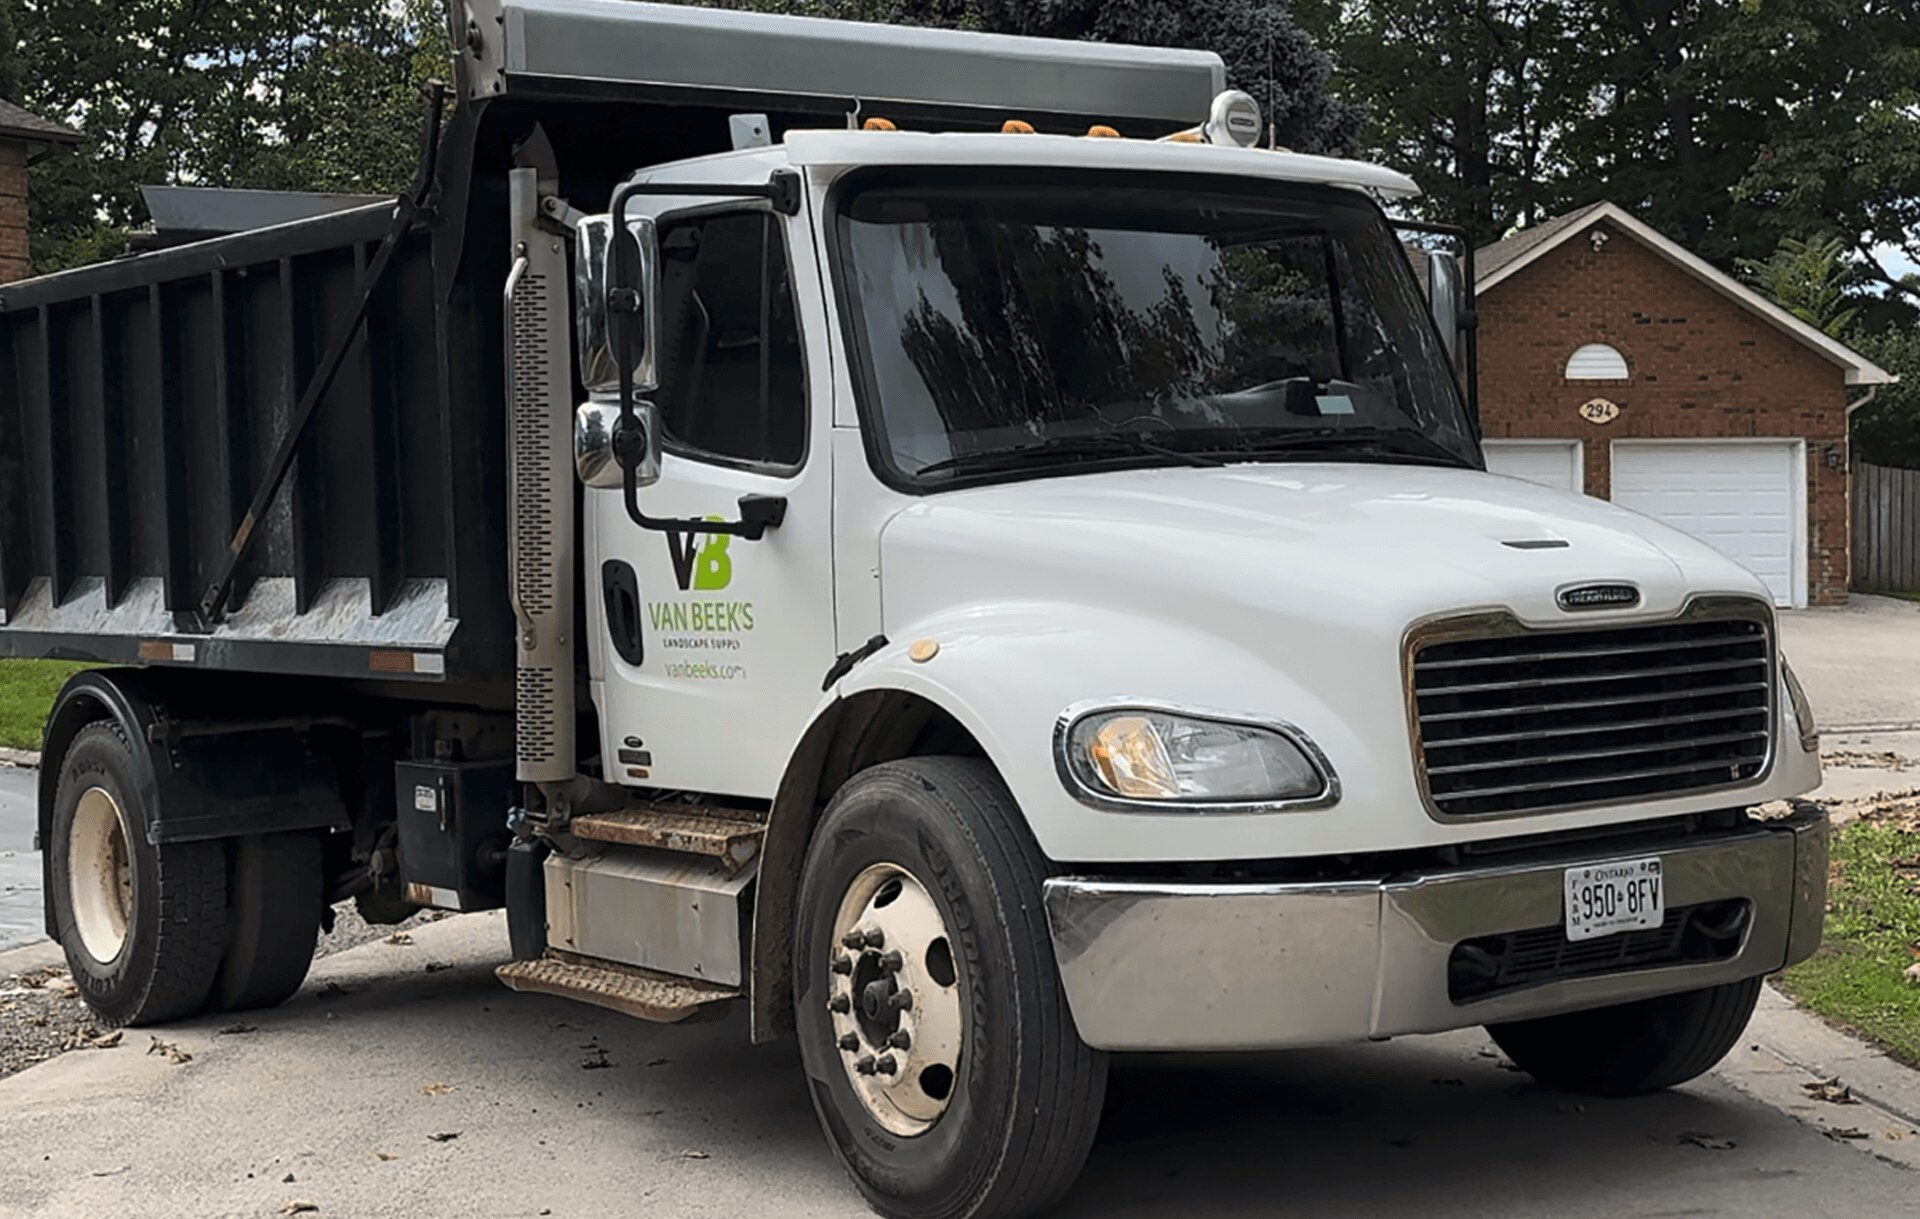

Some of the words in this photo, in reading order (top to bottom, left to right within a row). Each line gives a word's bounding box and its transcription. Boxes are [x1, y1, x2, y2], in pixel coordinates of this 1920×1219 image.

[1586, 403, 1612, 418] 294
[664, 514, 732, 591] VB
[648, 602, 688, 631] VAN
[691, 602, 754, 631] BEEK'S
[663, 638, 709, 649] LANDSCAPE
[710, 638, 740, 650] SUPPLY
[664, 659, 746, 680] vanbeeks.com
[1582, 883, 1616, 919] 950
[1627, 877, 1659, 913] 8FV
